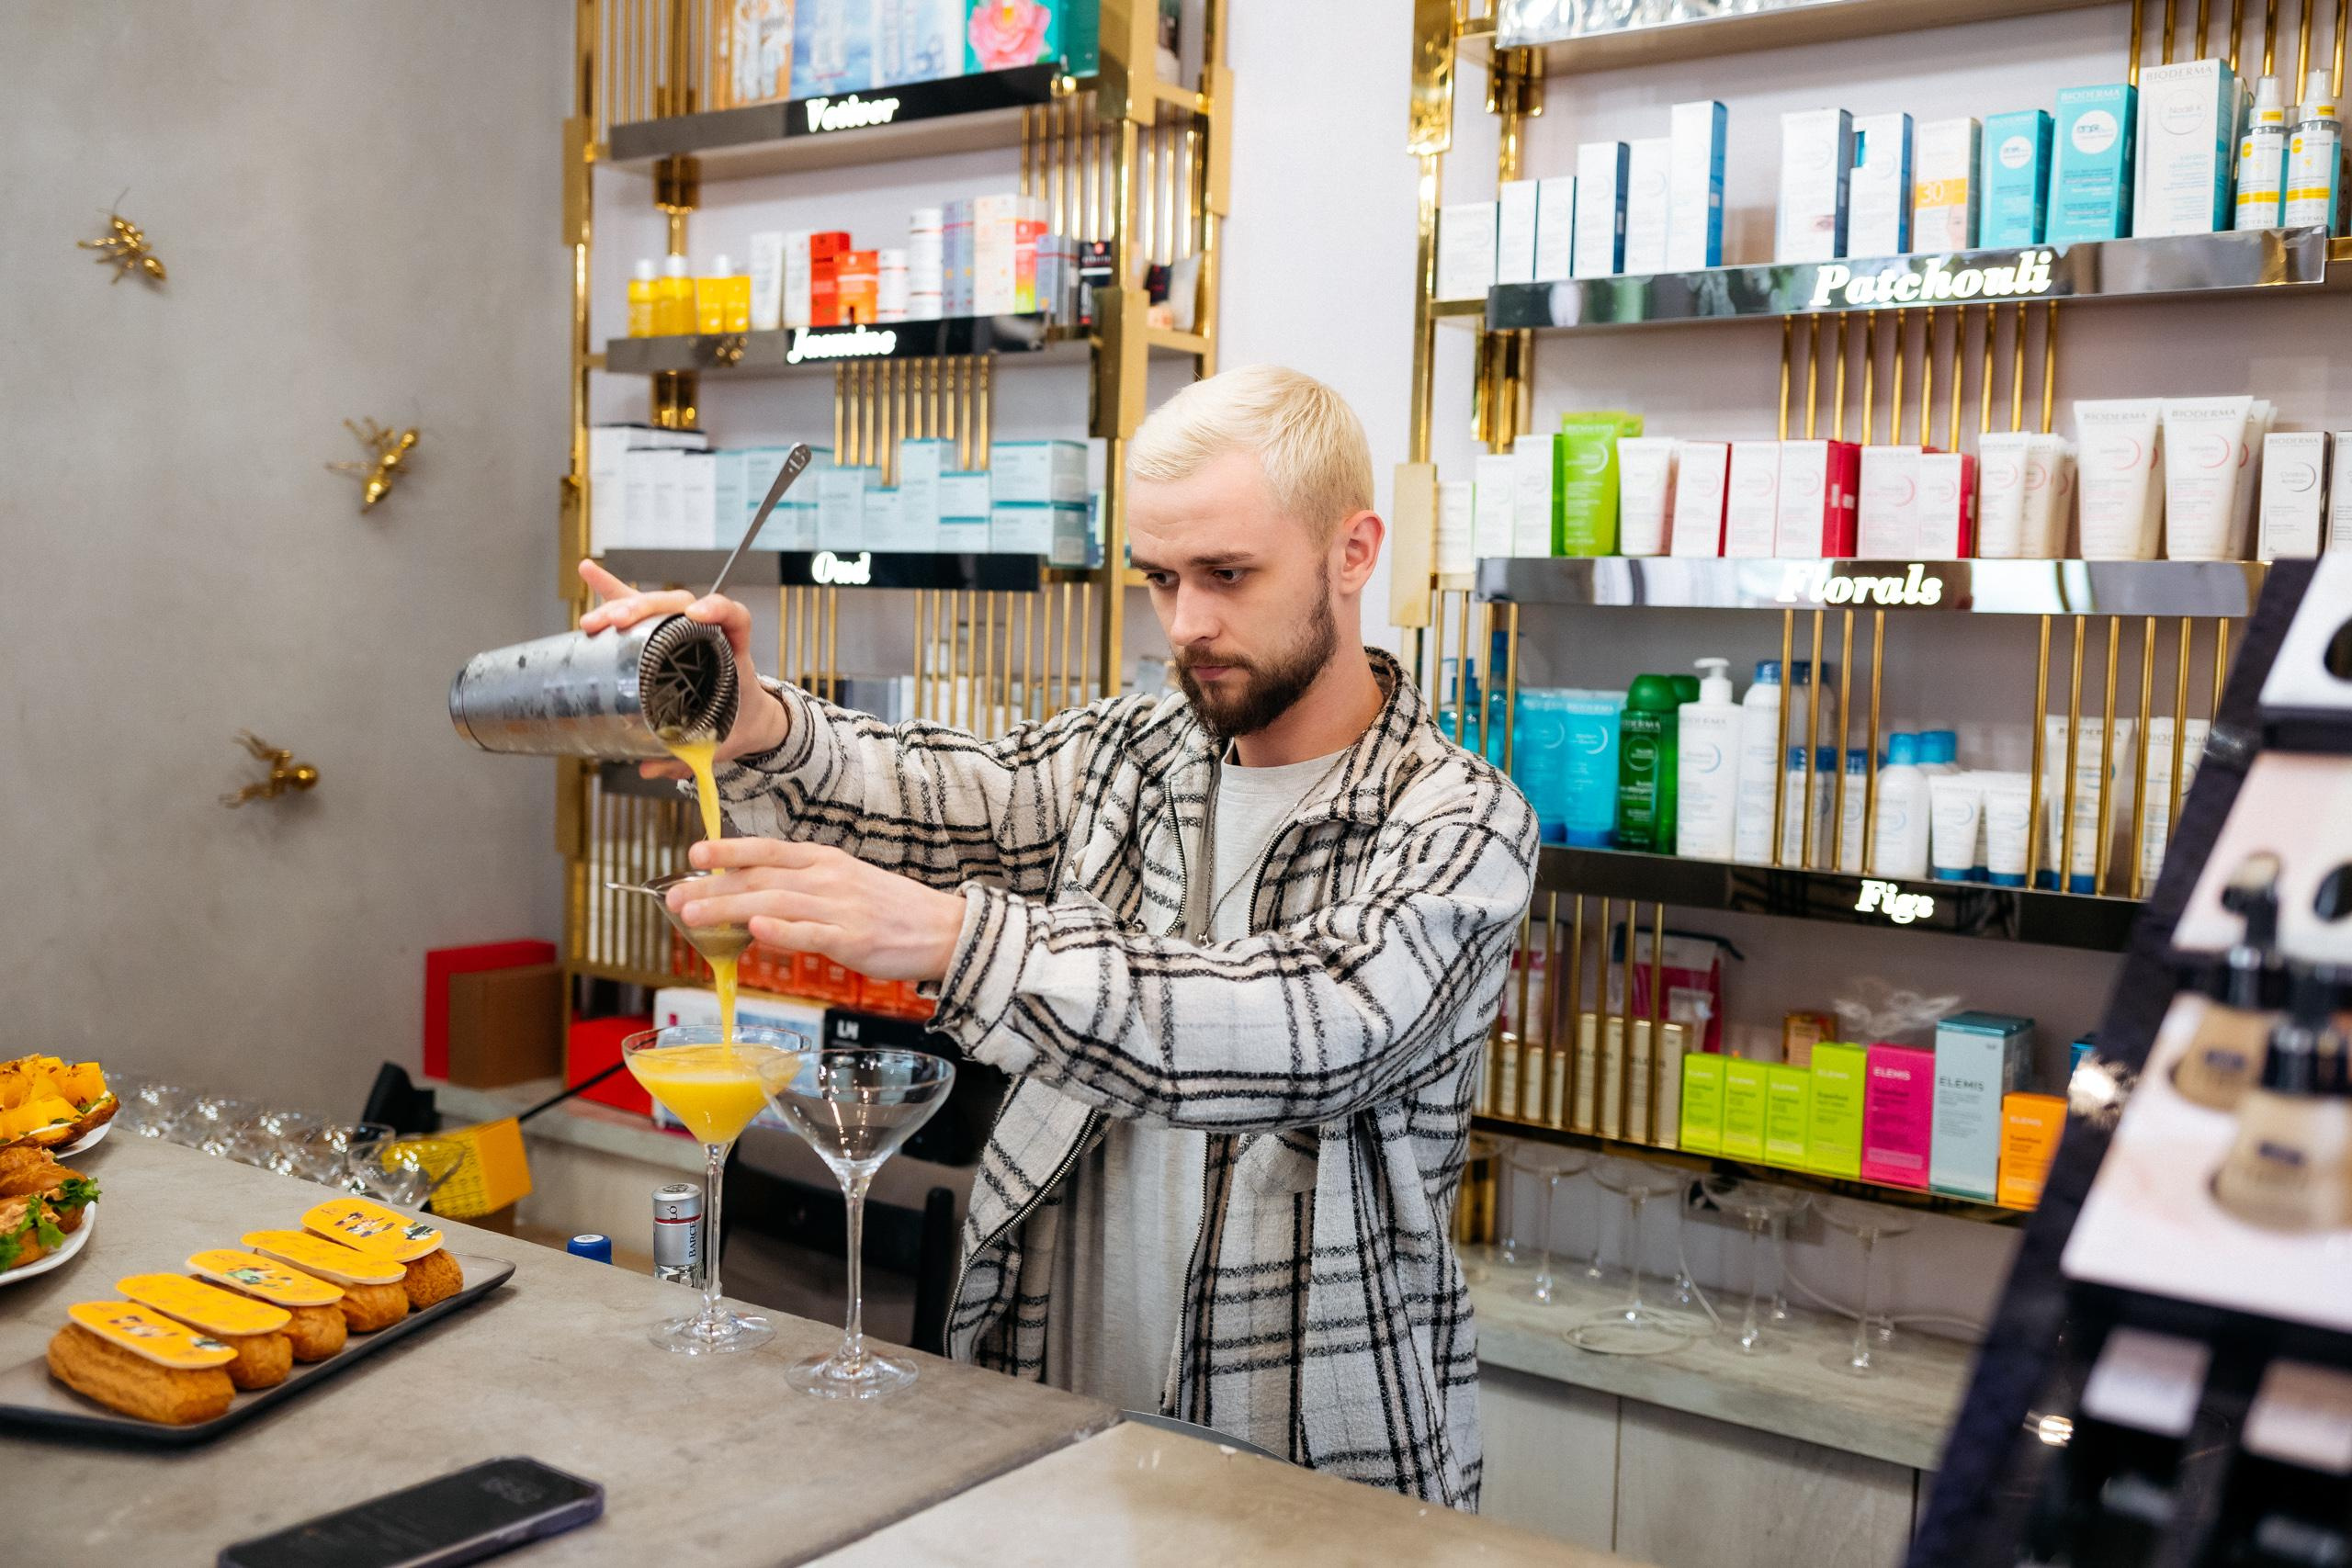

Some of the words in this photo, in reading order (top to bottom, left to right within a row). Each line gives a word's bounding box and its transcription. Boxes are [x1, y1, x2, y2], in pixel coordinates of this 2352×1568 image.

[1921, 183, 1944, 202] 30
[1809, 251, 2052, 306] Patchouli
[1776, 563, 1942, 605] Florals
[1855, 880, 1934, 923] Figs
[1872, 1067, 1911, 1080] ELEMIS
[1939, 1076, 1984, 1092] ELEMIS
